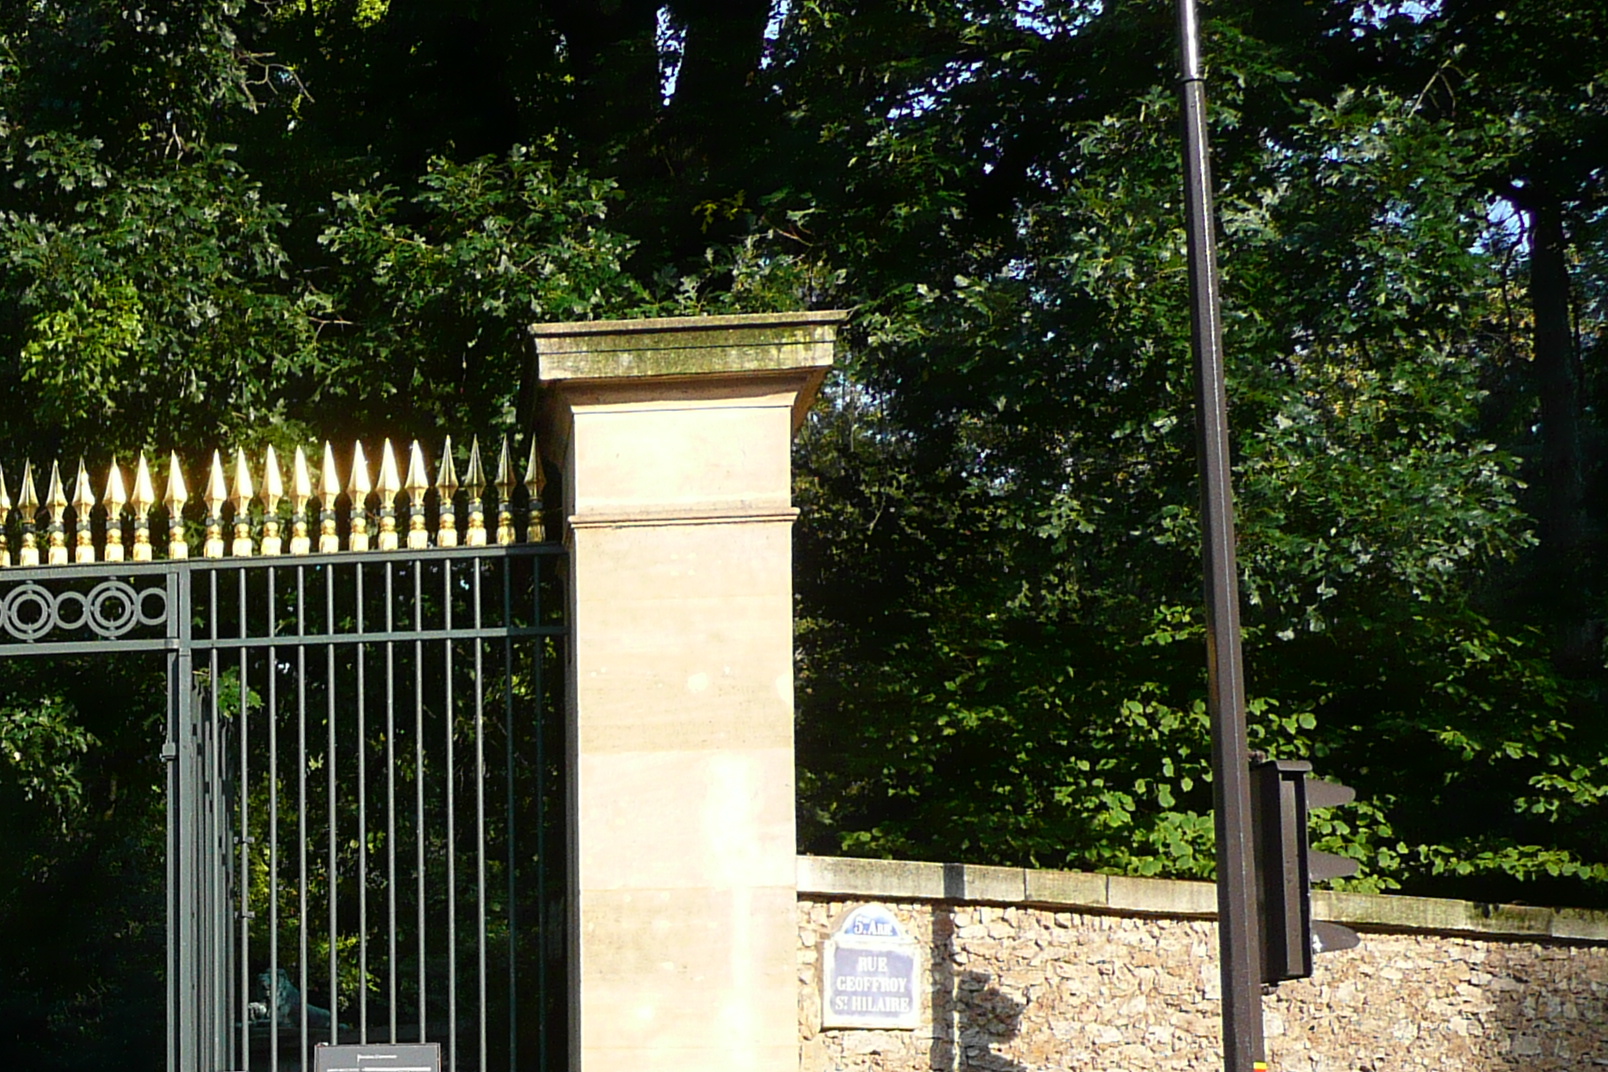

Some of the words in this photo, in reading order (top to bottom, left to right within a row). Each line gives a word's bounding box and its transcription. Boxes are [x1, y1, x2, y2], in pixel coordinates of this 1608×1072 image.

[858, 956, 888, 972] RUE
[836, 976, 907, 993] GEOFFROY
[852, 996, 910, 1012] HILAIRE
